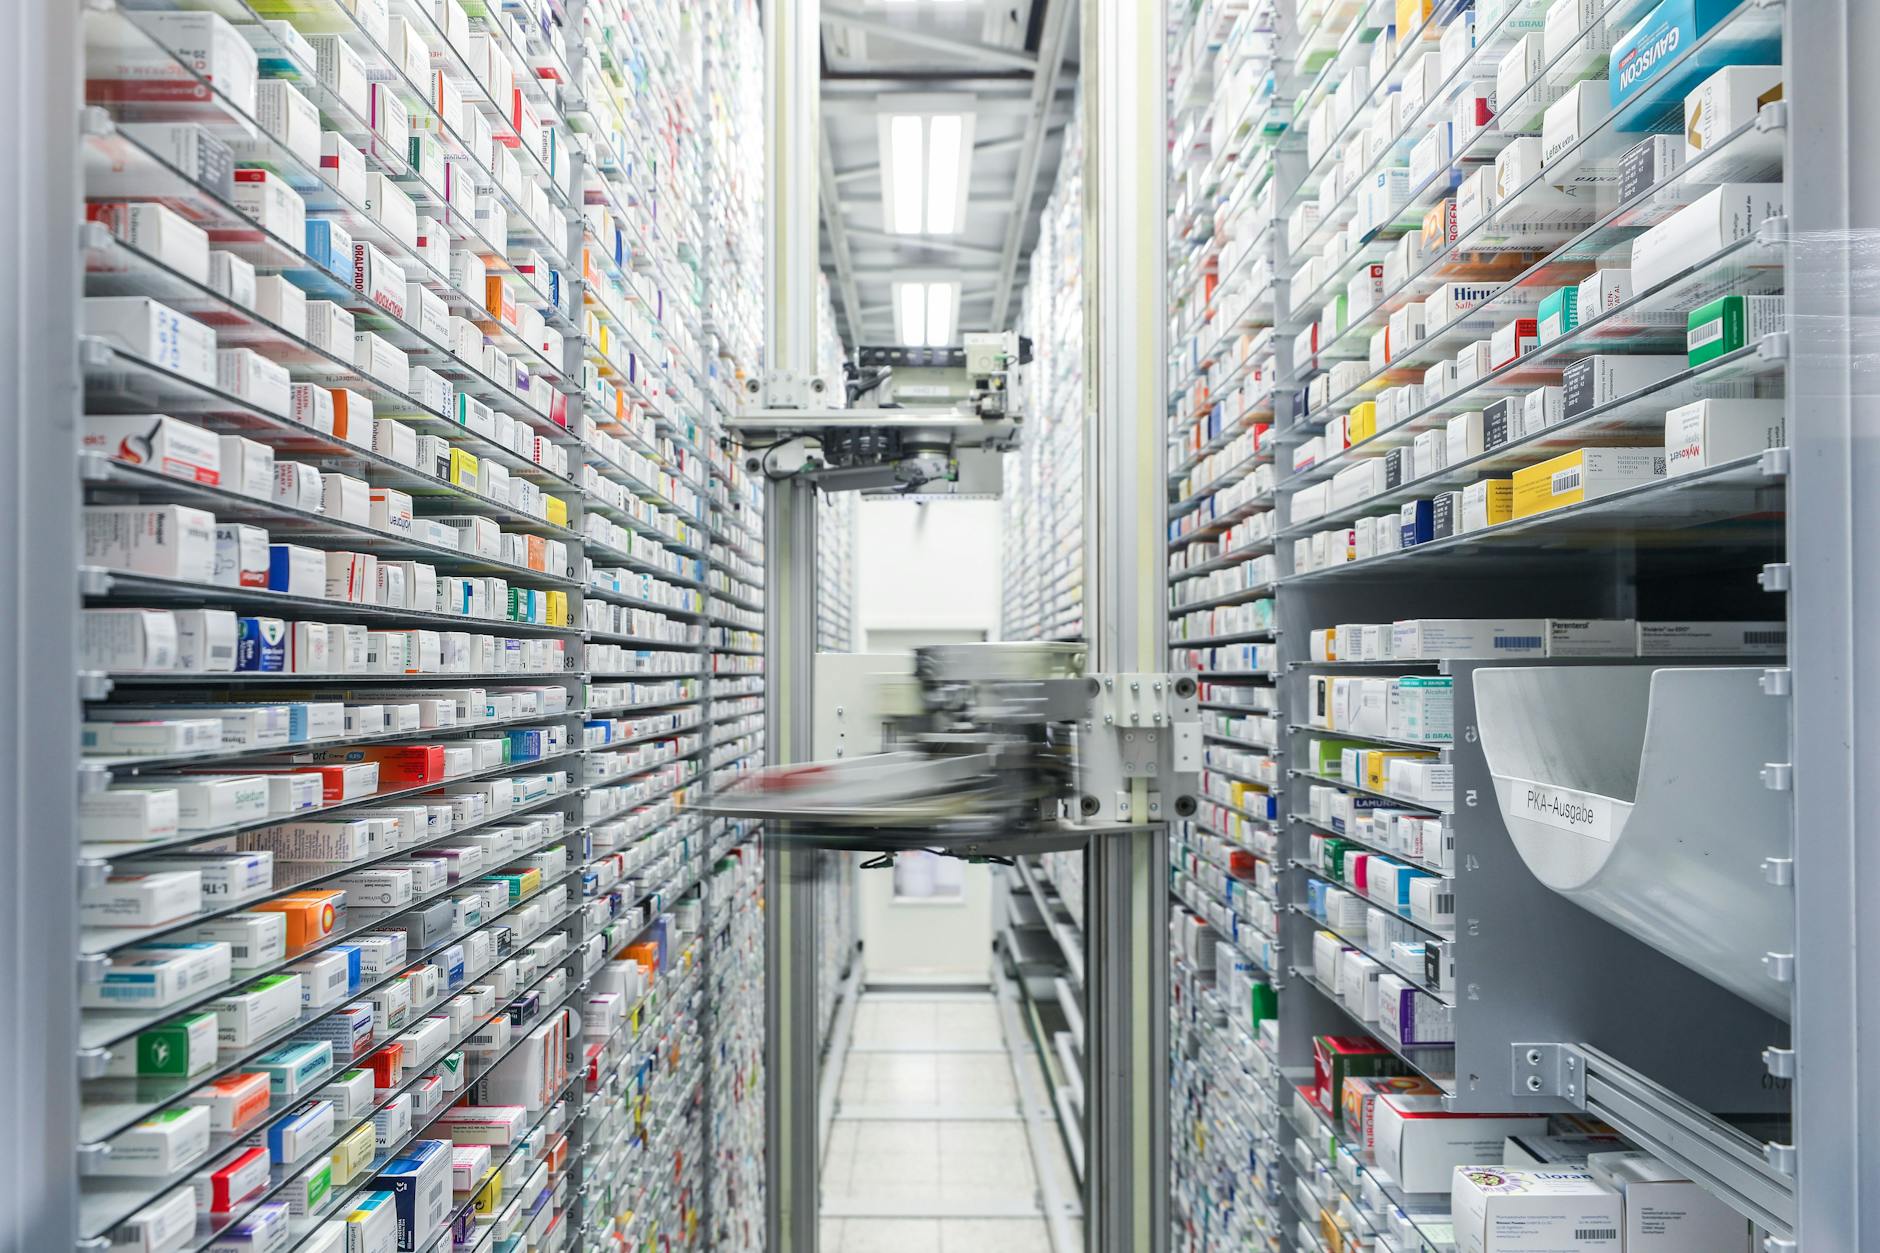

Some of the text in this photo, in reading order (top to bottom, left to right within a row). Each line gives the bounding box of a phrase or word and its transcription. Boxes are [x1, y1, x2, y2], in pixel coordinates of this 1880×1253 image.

[1619, 26, 1680, 92] GAVISCON
[1545, 134, 1575, 161] Lefax extra
[354, 243, 364, 293] ORALPÄDO
[1669, 443, 1700, 463] Mykosert
[389, 512, 412, 535] Voltaren
[1551, 621, 1590, 630] Perenterol
[312, 750, 327, 762] ort
[1527, 789, 1594, 824] PKA-Ausgabe
[1366, 1098, 1374, 1148] NUROFEN
[1534, 1172, 1595, 1181] Lioran
